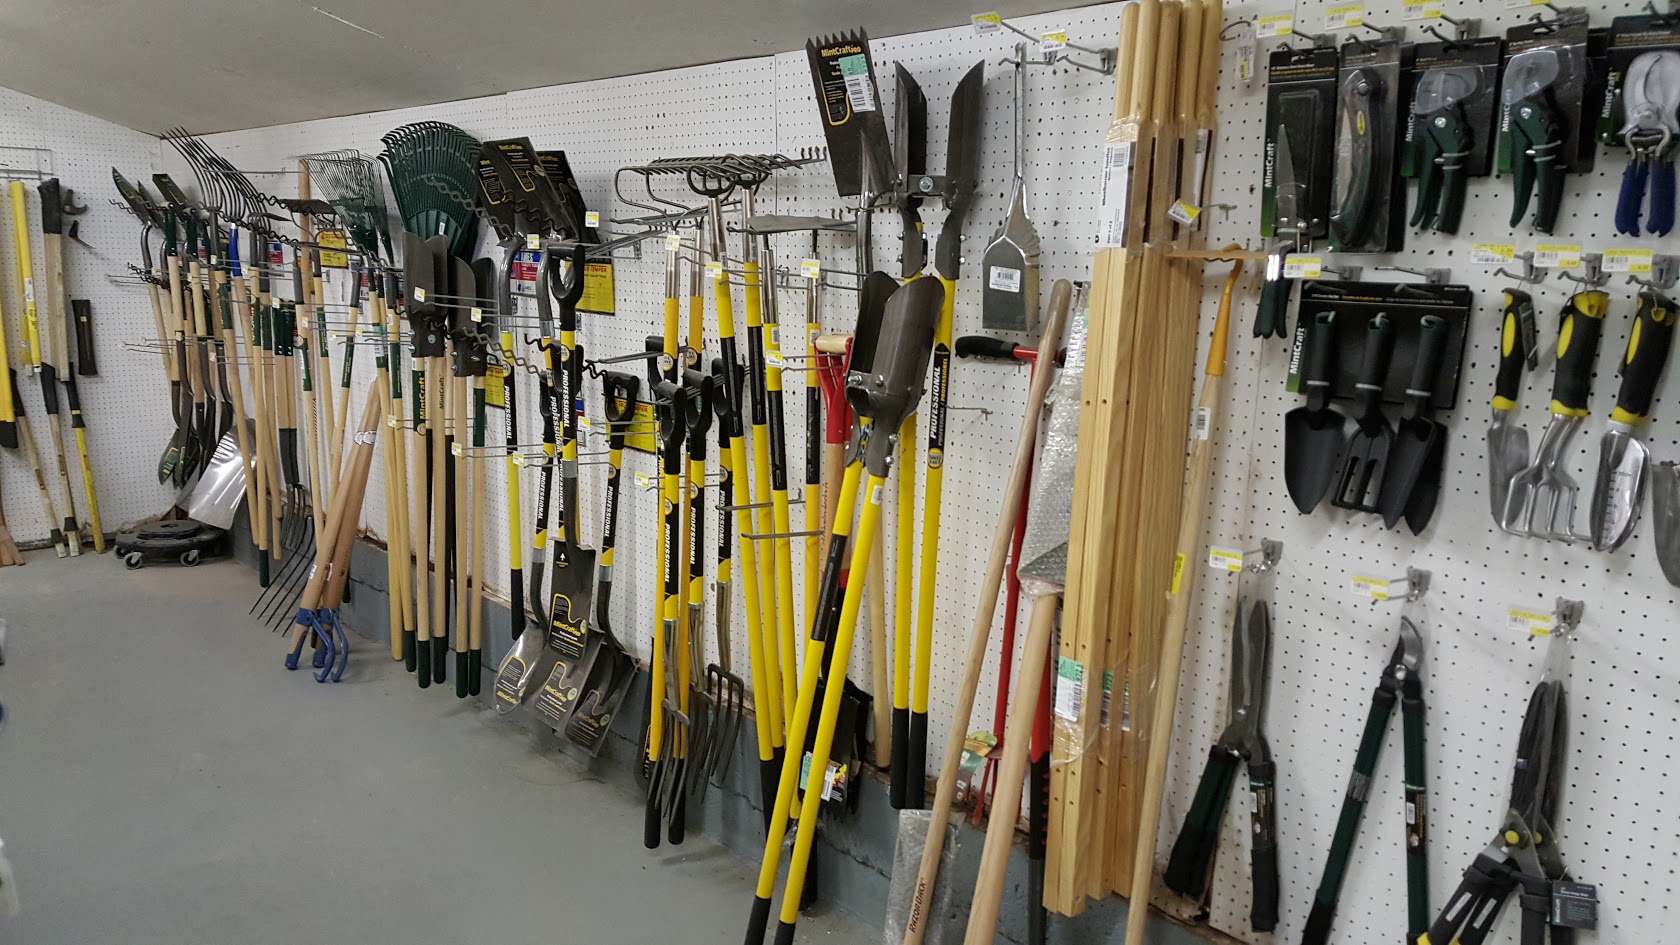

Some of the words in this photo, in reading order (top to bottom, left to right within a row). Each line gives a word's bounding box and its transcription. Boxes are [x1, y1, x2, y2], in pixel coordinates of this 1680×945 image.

[1601, 71, 1617, 118] MintCraft
[1264, 142, 1275, 188] MintCraft
[1290, 327, 1305, 374] MintCraft
[504, 385, 513, 440] PROFESSIONAL
[562, 369, 570, 428] PROFESSIONAL
[929, 366, 941, 440] PROFESSIONAL
[538, 471, 547, 520] PROFESSIONAL
[604, 485, 614, 538] PROFESSIONAL
[718, 489, 726, 548] PROESSIONAL
